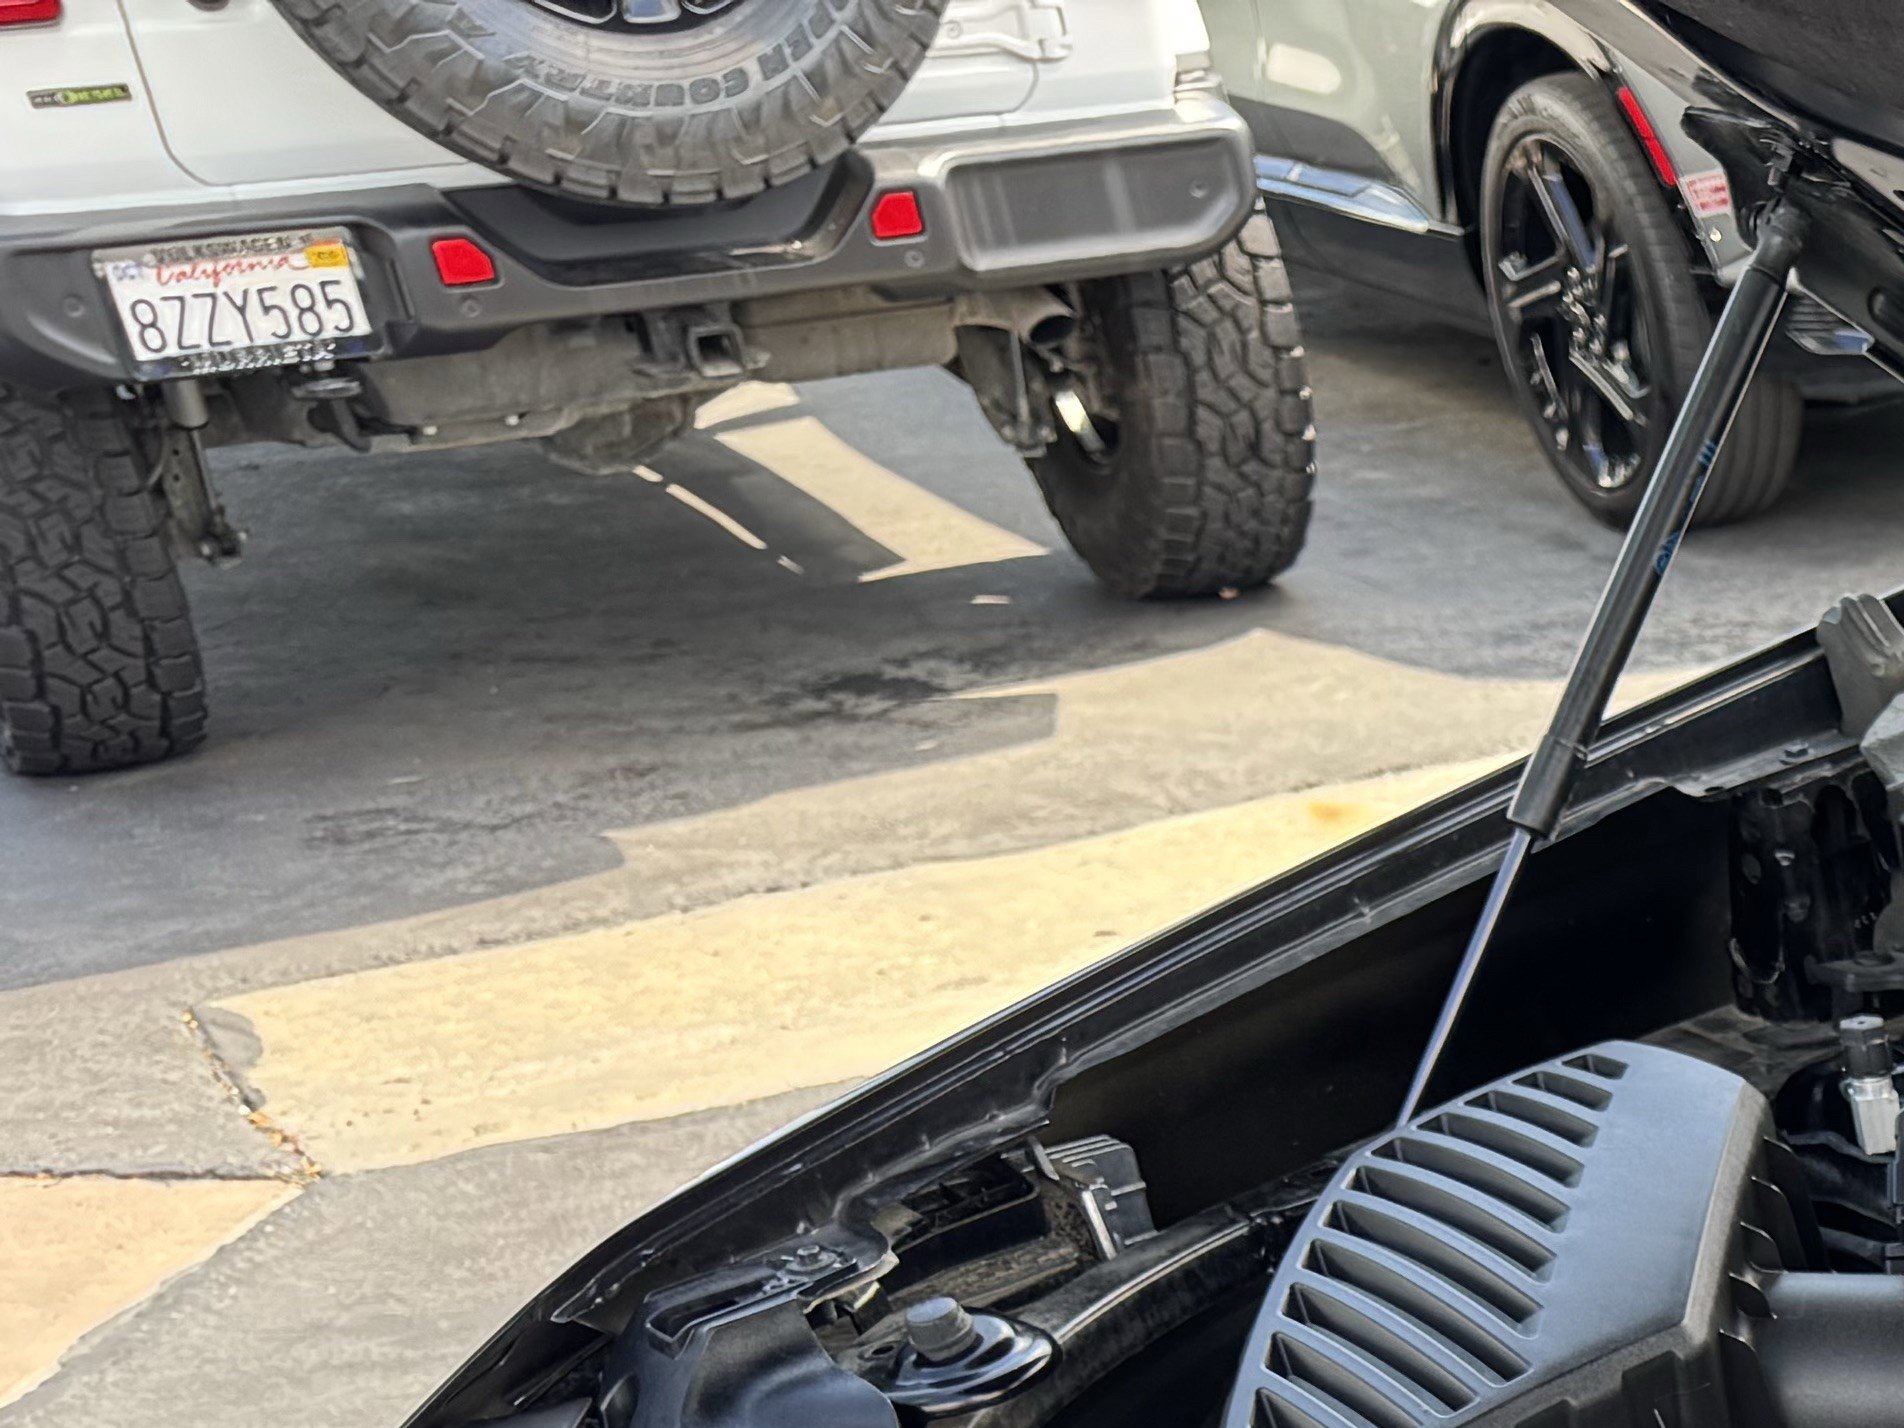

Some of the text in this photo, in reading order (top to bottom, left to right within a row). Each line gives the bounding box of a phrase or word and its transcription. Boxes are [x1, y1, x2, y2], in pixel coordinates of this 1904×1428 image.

[503, 50, 751, 106] COUNTRY
[157, 254, 304, 288] California
[130, 279, 355, 354] 8ZZY585
